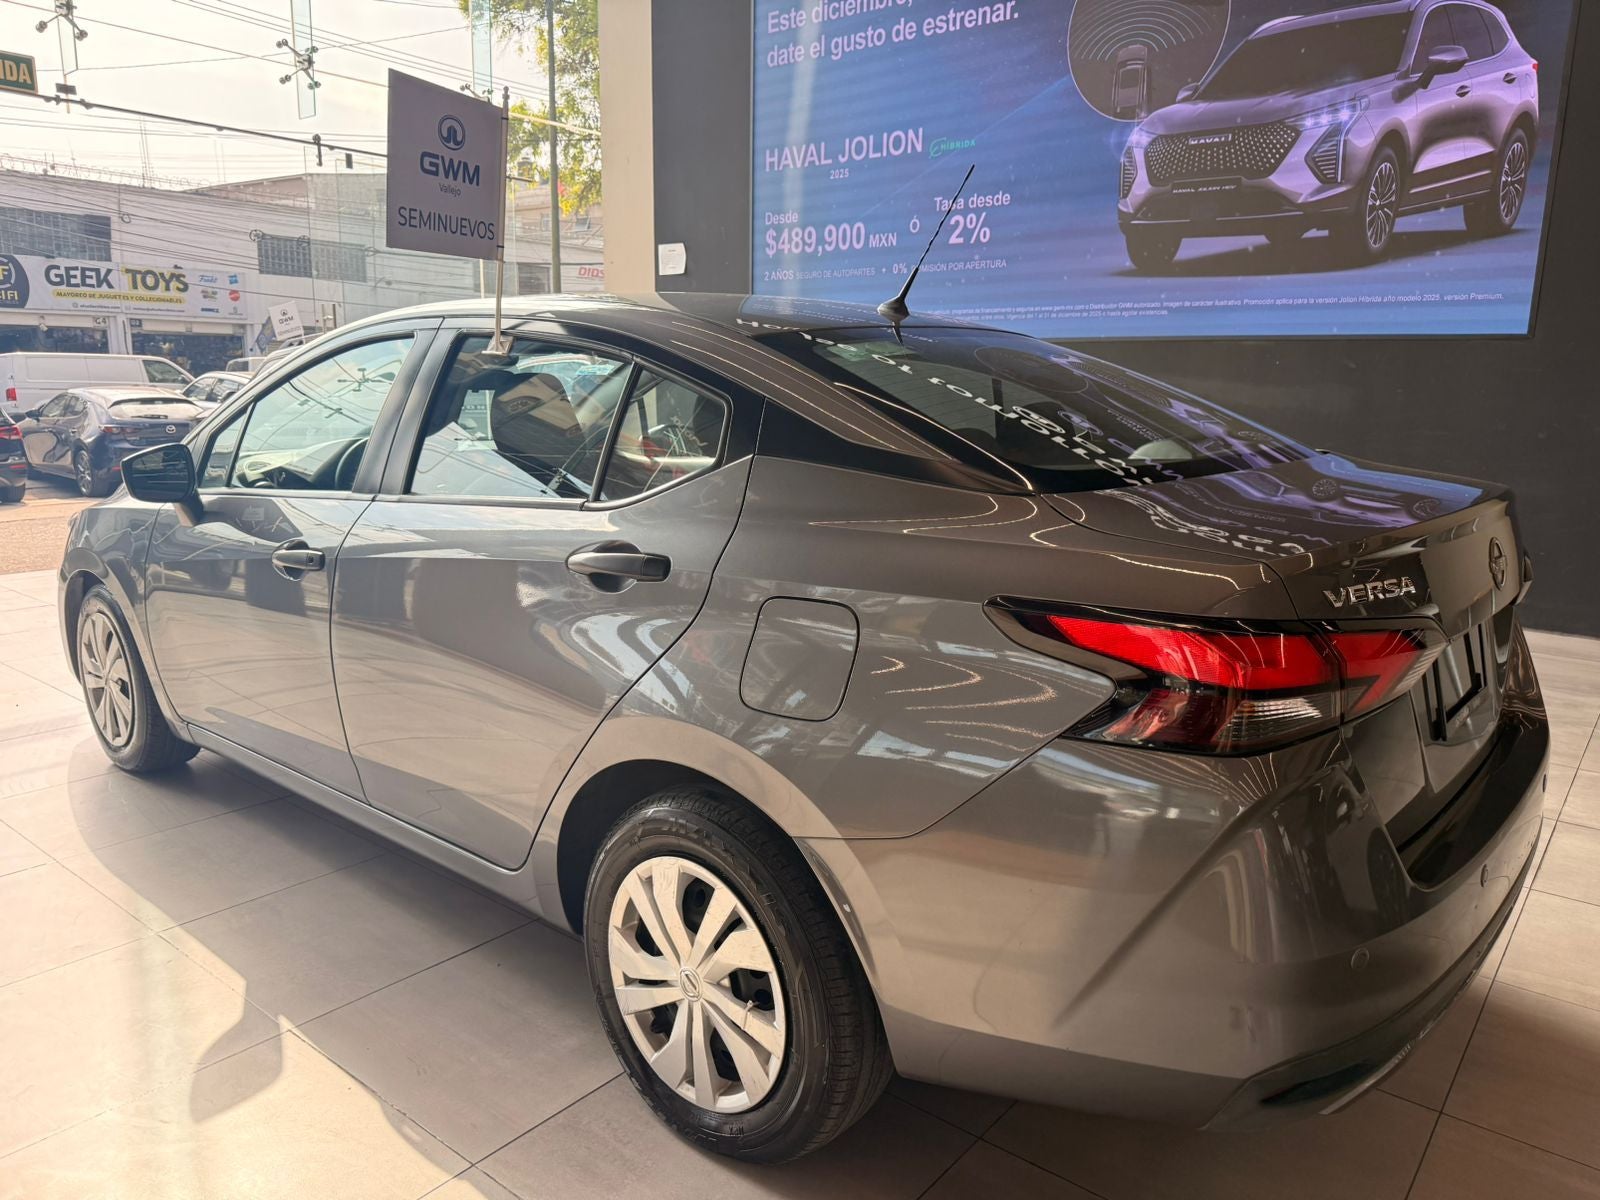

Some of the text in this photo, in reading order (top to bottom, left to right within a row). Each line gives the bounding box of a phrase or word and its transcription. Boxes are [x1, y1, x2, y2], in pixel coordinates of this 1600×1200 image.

[767, 0, 913, 33] Este diciemb,
[767, 0, 1019, 68] date el gusto de estrenar.
[765, 142, 833, 172] HAVAL
[838, 127, 923, 164] JOLION
[420, 151, 480, 187] GWM
[829, 168, 849, 179] 2025
[438, 182, 462, 197] Vallejo
[968, 190, 1011, 209] desde
[398, 206, 495, 241] SEMINUEVOS
[765, 210, 799, 225] Desde
[909, 216, 920, 233] Ó
[948, 211, 991, 244] 2%
[765, 222, 897, 258] $489,900 MXN
[45, 264, 189, 293] GEEK TOYS
[764, 271, 769, 280] 2
[770, 269, 794, 280] AÑOS
[795, 270, 822, 280] SEGURO
[823, 269, 832, 278] DE
[832, 267, 876, 278] AUTOPARTES
[892, 262, 908, 275] 0%
[911, 263, 946, 273] MISIÓN
[948, 261, 965, 271] POR
[965, 258, 1007, 269] APERTURA
[56, 291, 88, 299] MAYOREO
[1324, 576, 1417, 608] VERSA
